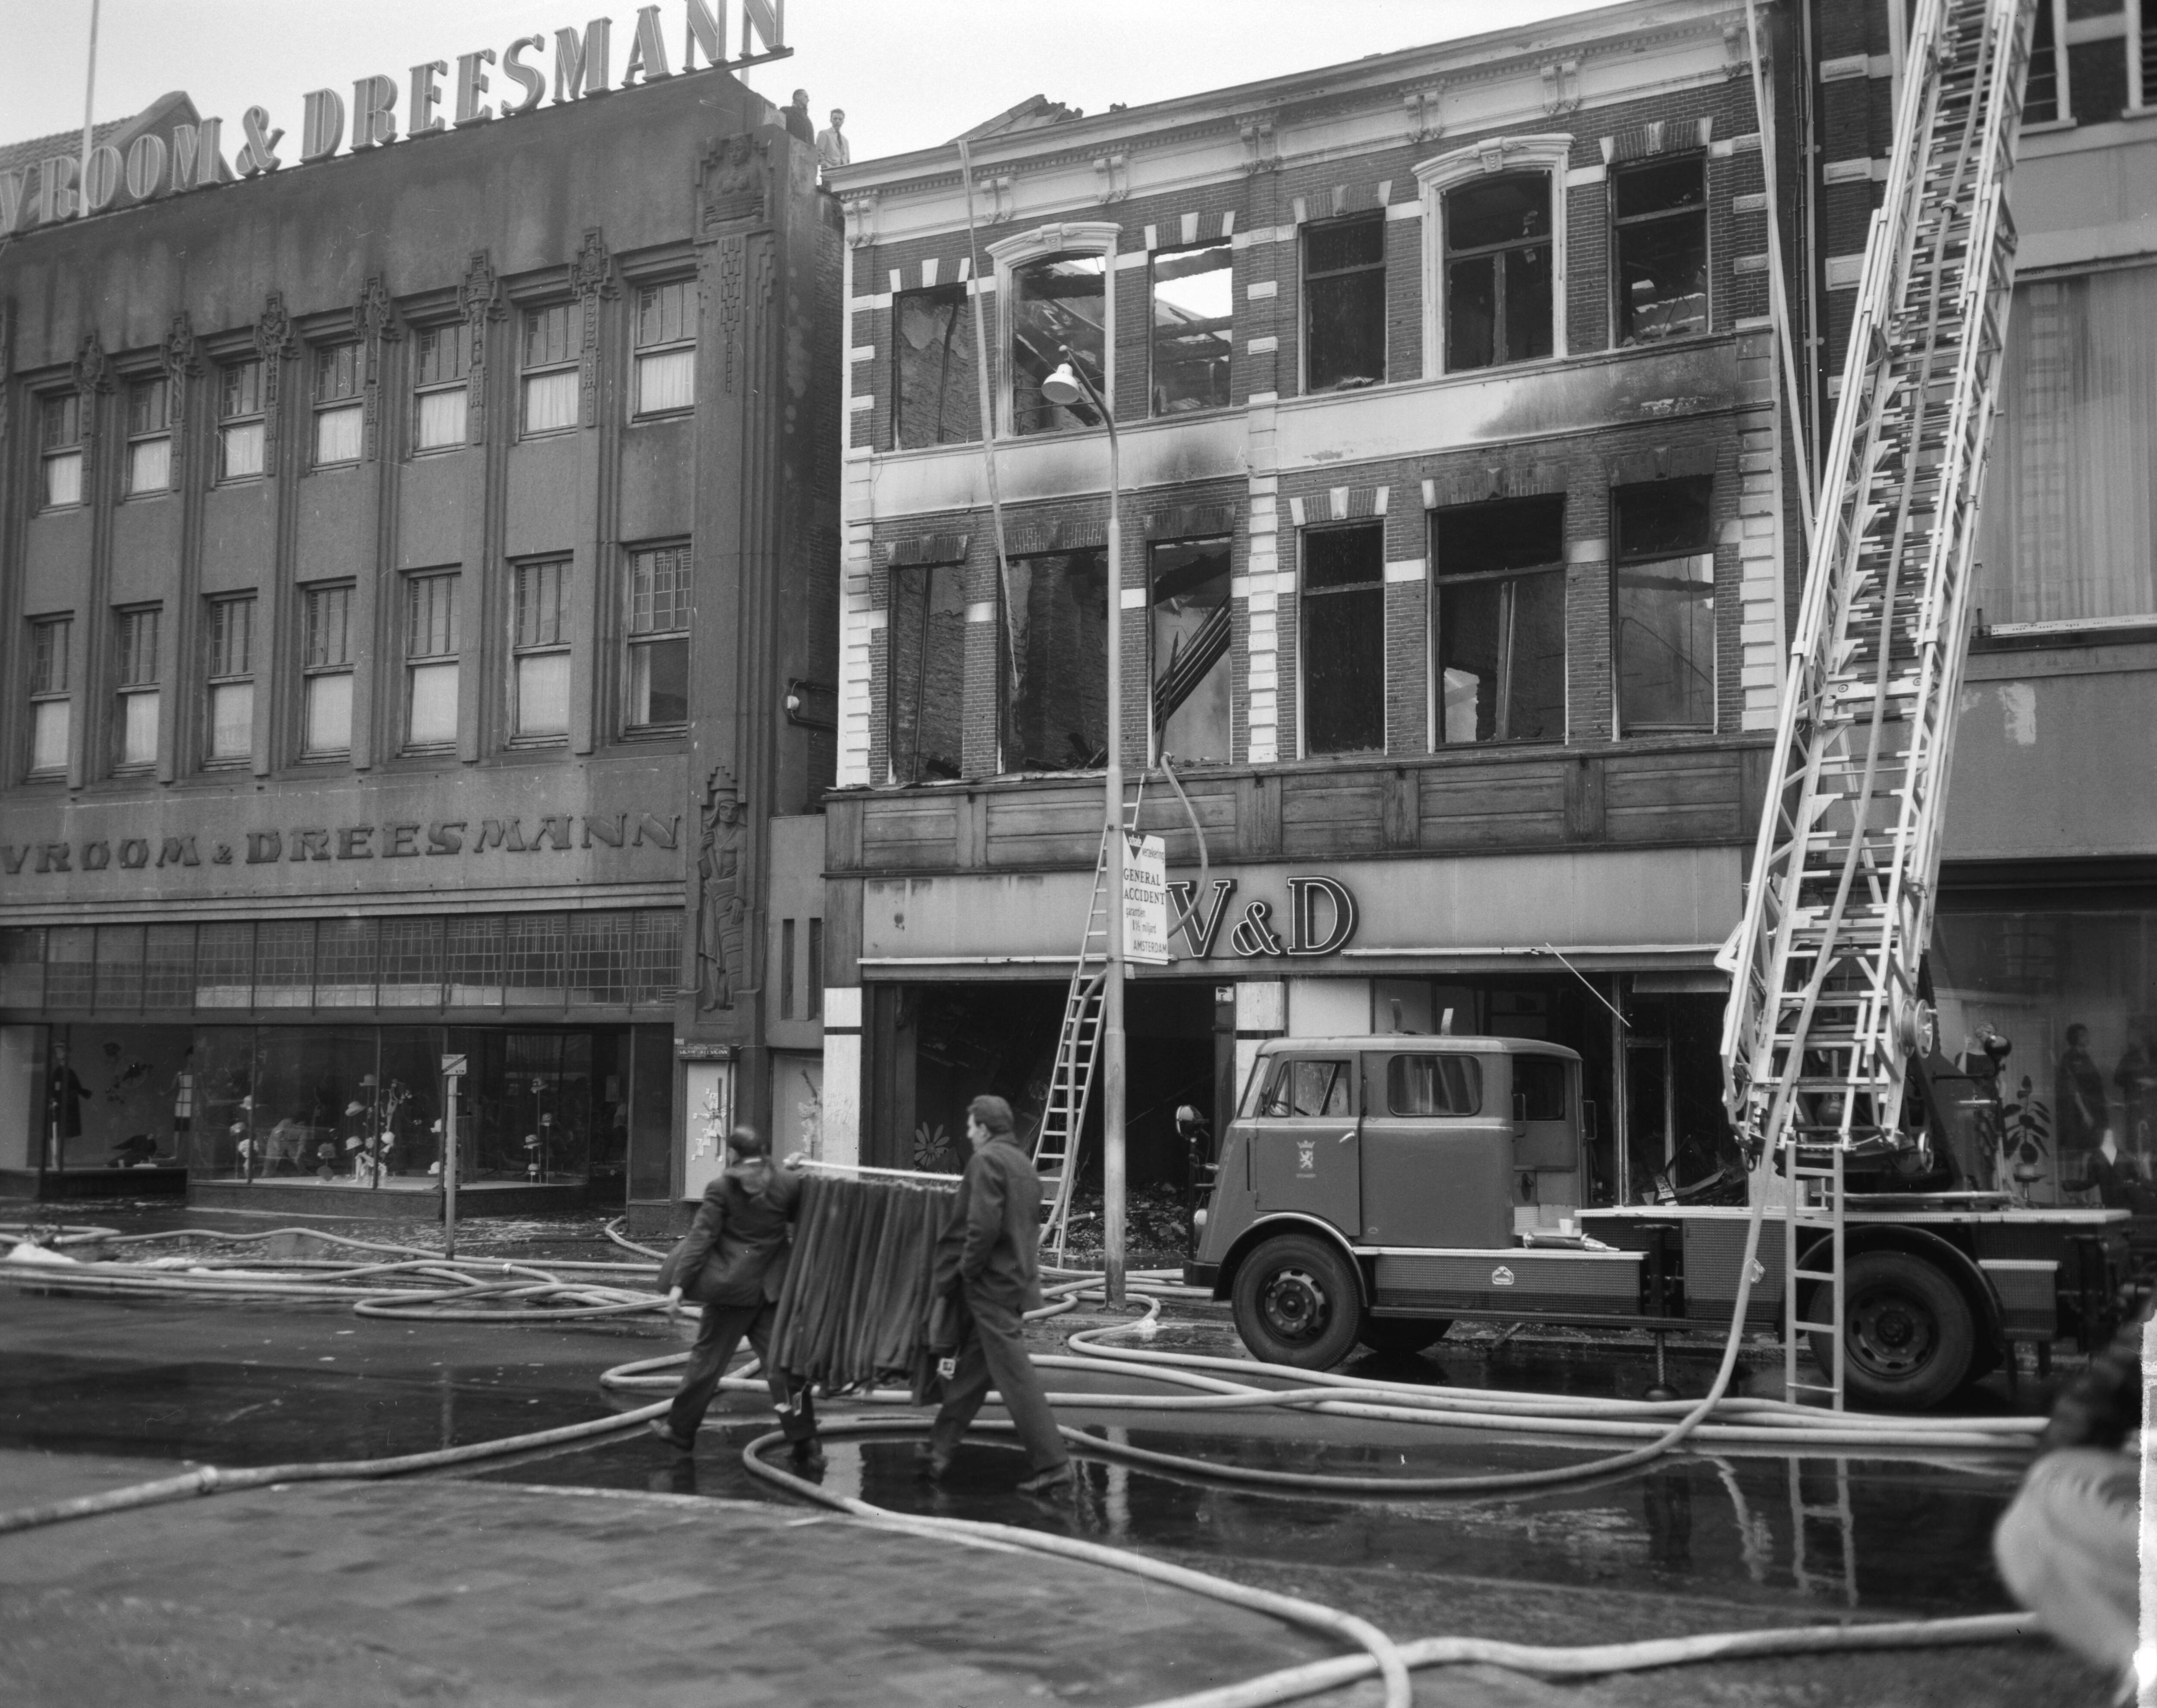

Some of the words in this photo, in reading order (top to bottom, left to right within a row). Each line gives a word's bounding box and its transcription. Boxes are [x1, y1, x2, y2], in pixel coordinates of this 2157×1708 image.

[0, 116, 223, 235] VROOM
[236, 105, 285, 178] &
[299, 0, 786, 165] DREESMANN
[0, 836, 201, 874] VROOM
[212, 845, 233, 865] &
[245, 814, 681, 864] DREESMANN
[1129, 834, 1142, 847] schade
[1142, 847, 1164, 864] verzekering
[1124, 868, 1160, 886] GENERAL
[1124, 887, 1165, 905] ACCIDENT
[1133, 940, 1167, 954] AMSTERDAM
